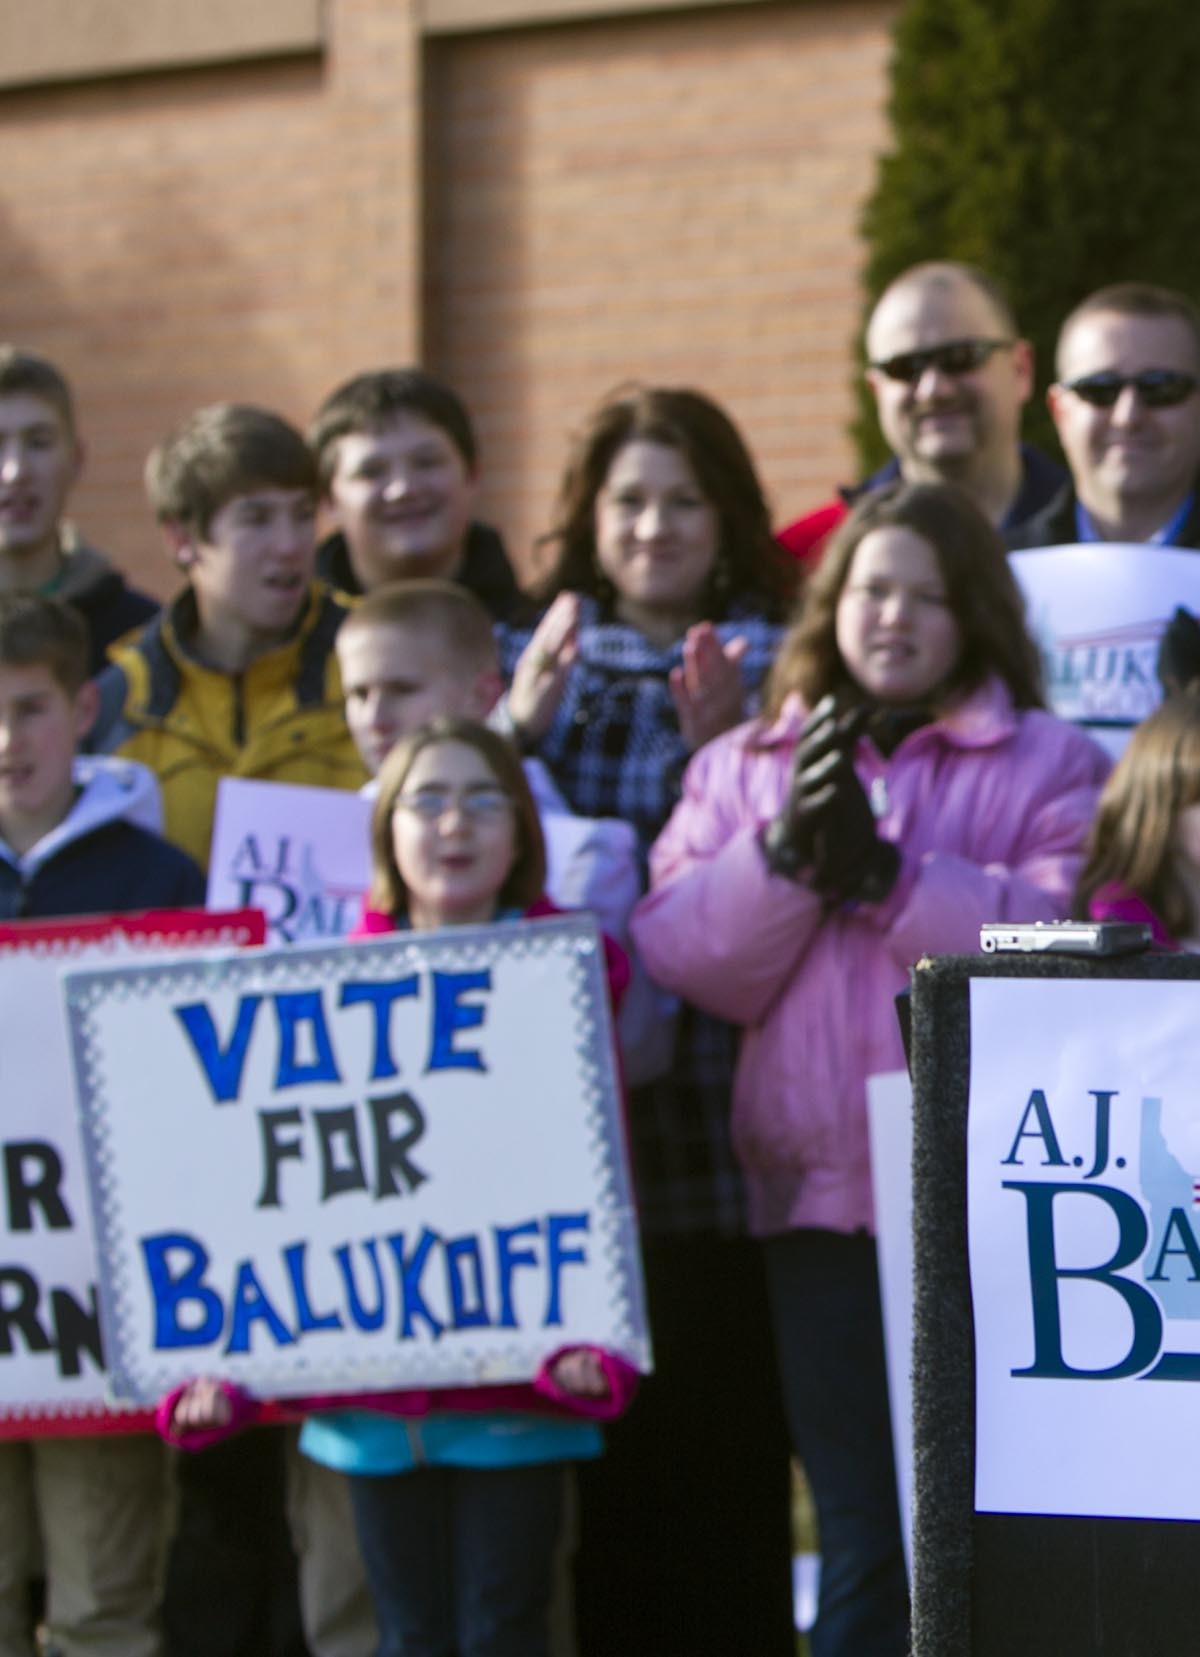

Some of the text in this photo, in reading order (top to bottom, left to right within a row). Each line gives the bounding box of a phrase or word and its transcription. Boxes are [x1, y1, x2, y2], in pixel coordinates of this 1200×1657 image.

[174, 968, 492, 1102] VOTE
[258, 1092, 429, 1206] FOR
[1000, 1088, 1127, 1180] A.J.
[140, 1213, 590, 1356] BALUKOFF
